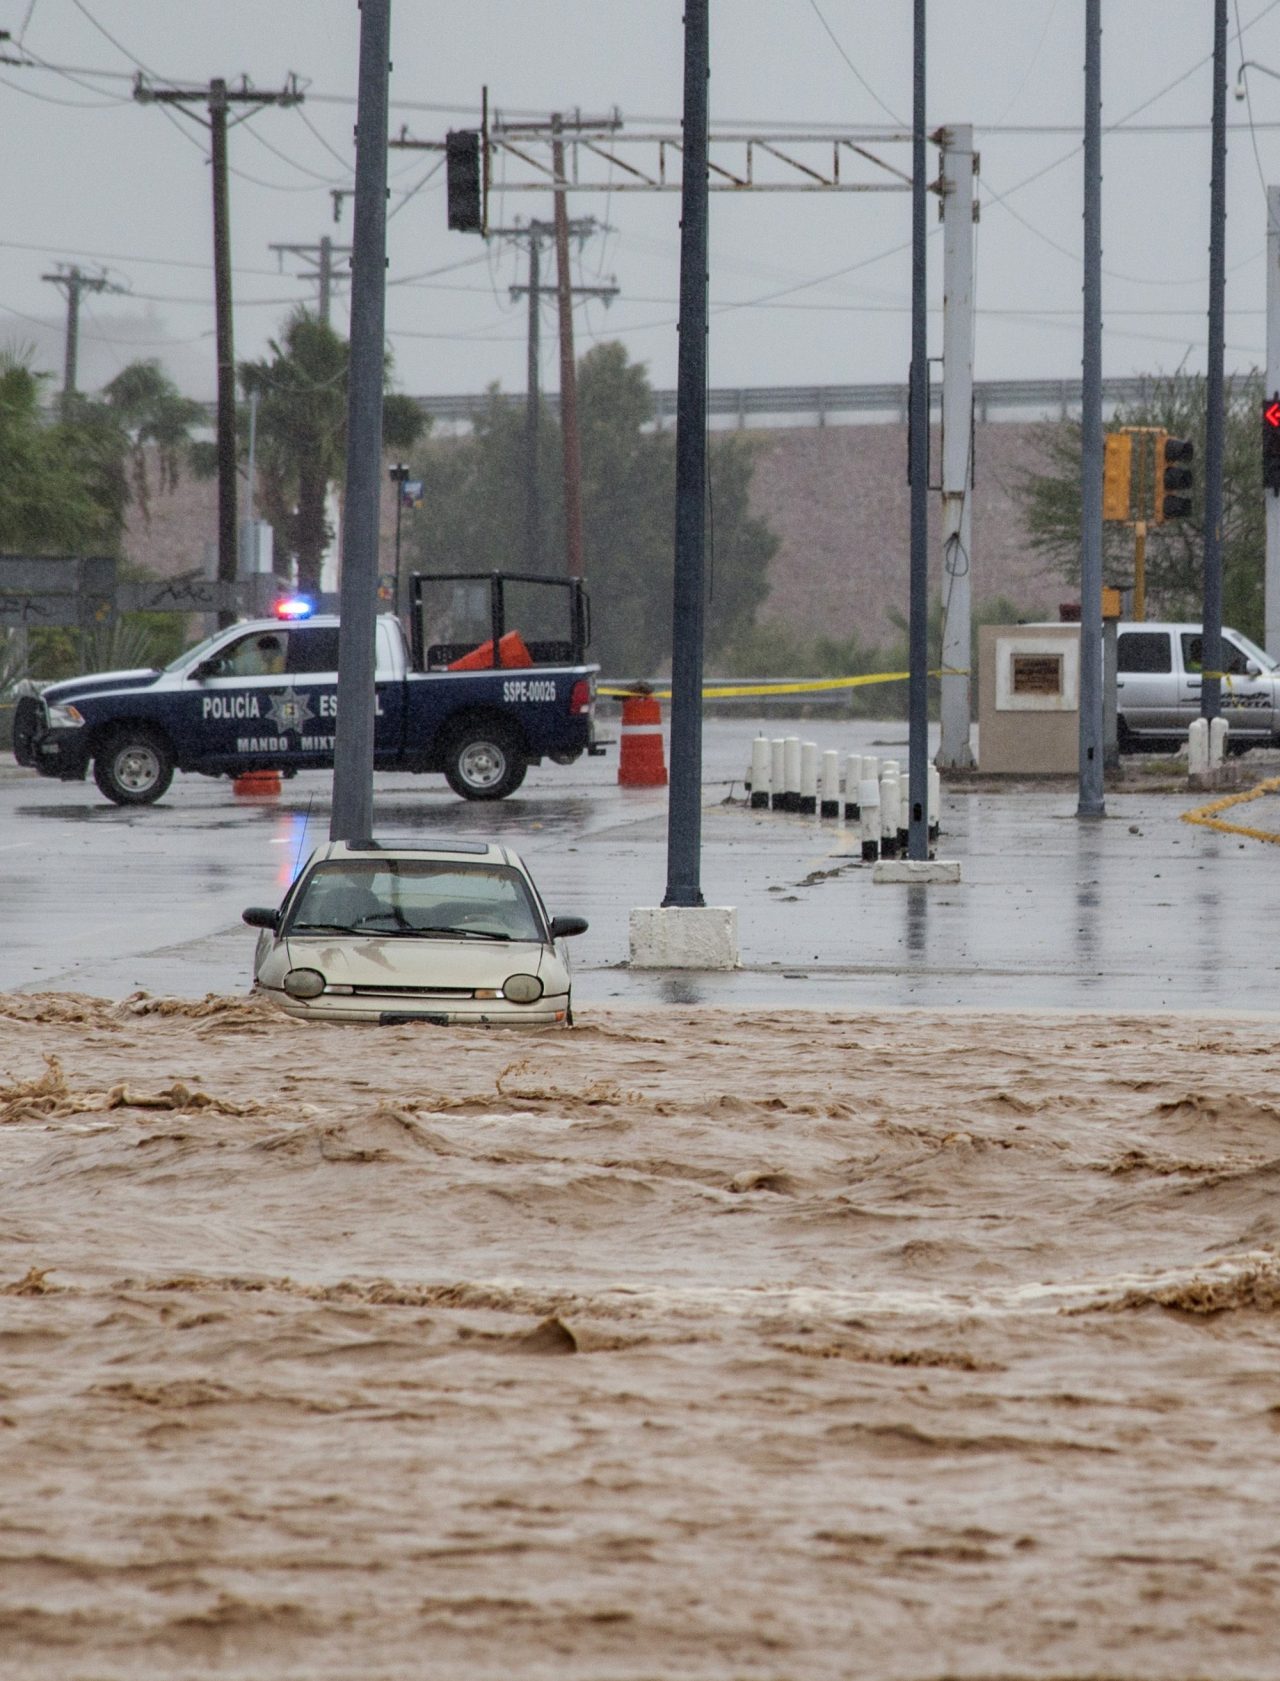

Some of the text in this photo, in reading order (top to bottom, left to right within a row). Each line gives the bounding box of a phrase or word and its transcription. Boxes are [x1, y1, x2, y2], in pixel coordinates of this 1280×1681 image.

[503, 681, 556, 702] SSPE-00026
[203, 693, 260, 719] POLICÍA
[237, 736, 337, 752] MANDO MIXT
